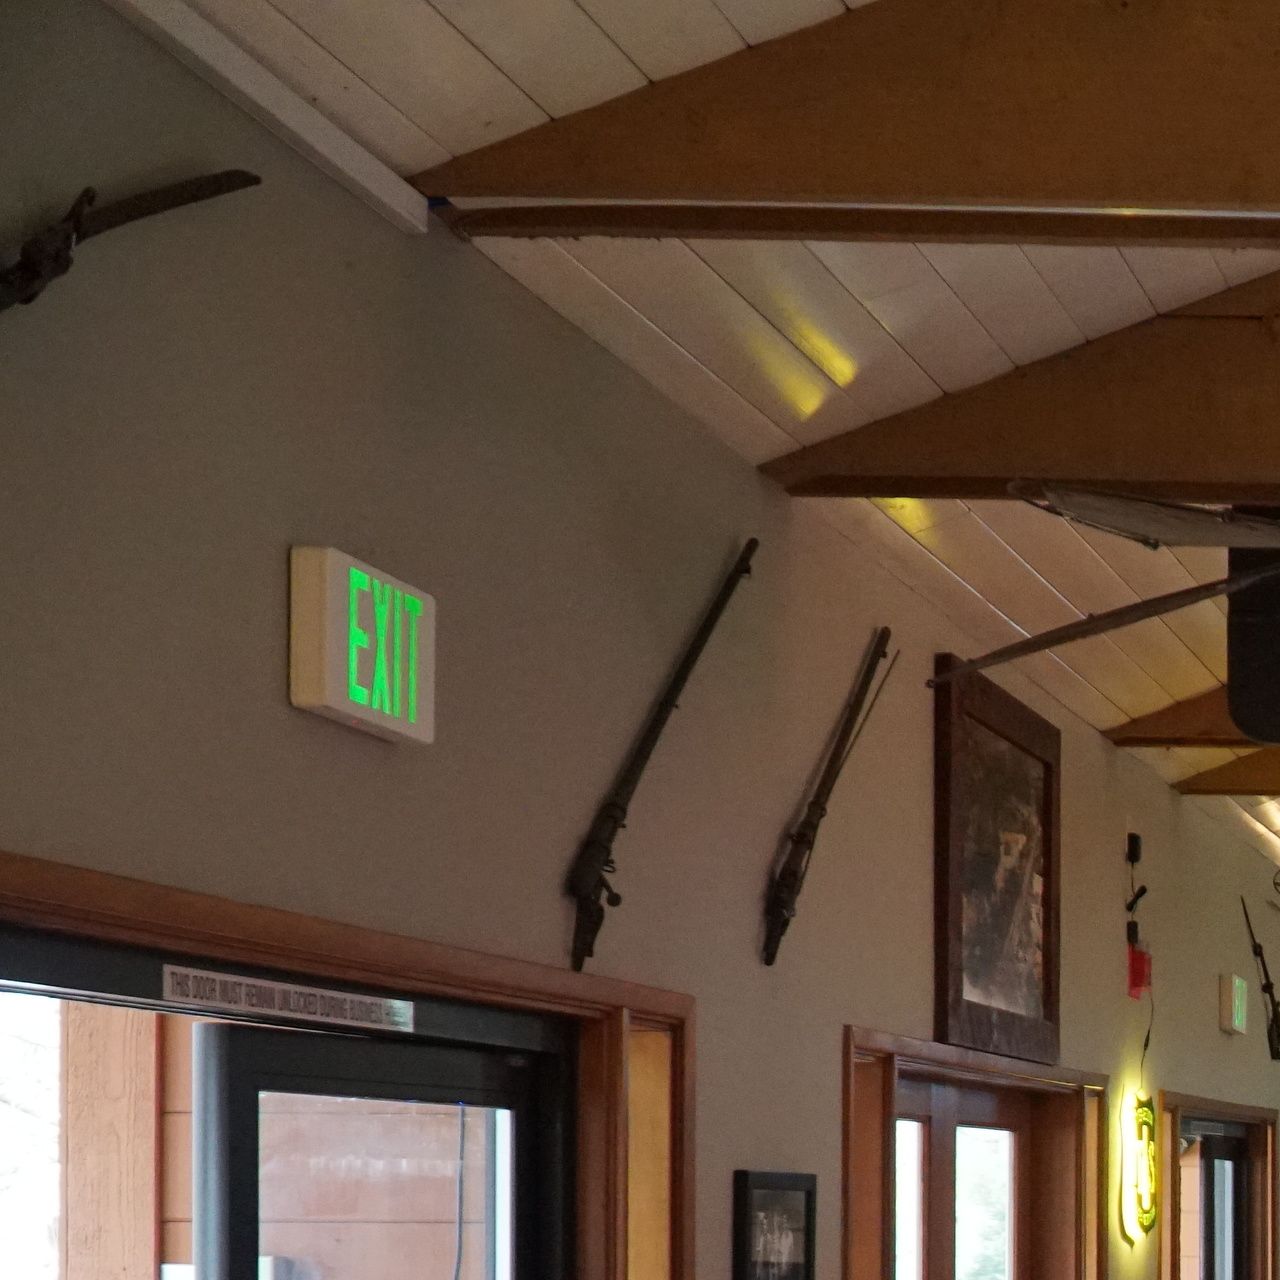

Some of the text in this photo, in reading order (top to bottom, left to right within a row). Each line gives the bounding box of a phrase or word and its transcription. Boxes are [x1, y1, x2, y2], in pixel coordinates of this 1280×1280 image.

[349, 567, 423, 723] EXIT
[171, 971, 190, 998] THIS
[192, 975, 217, 1001] DOOR
[219, 979, 243, 1005] MUST
[245, 983, 276, 1010] REMAIN
[278, 987, 318, 1015] UNLOCKED
